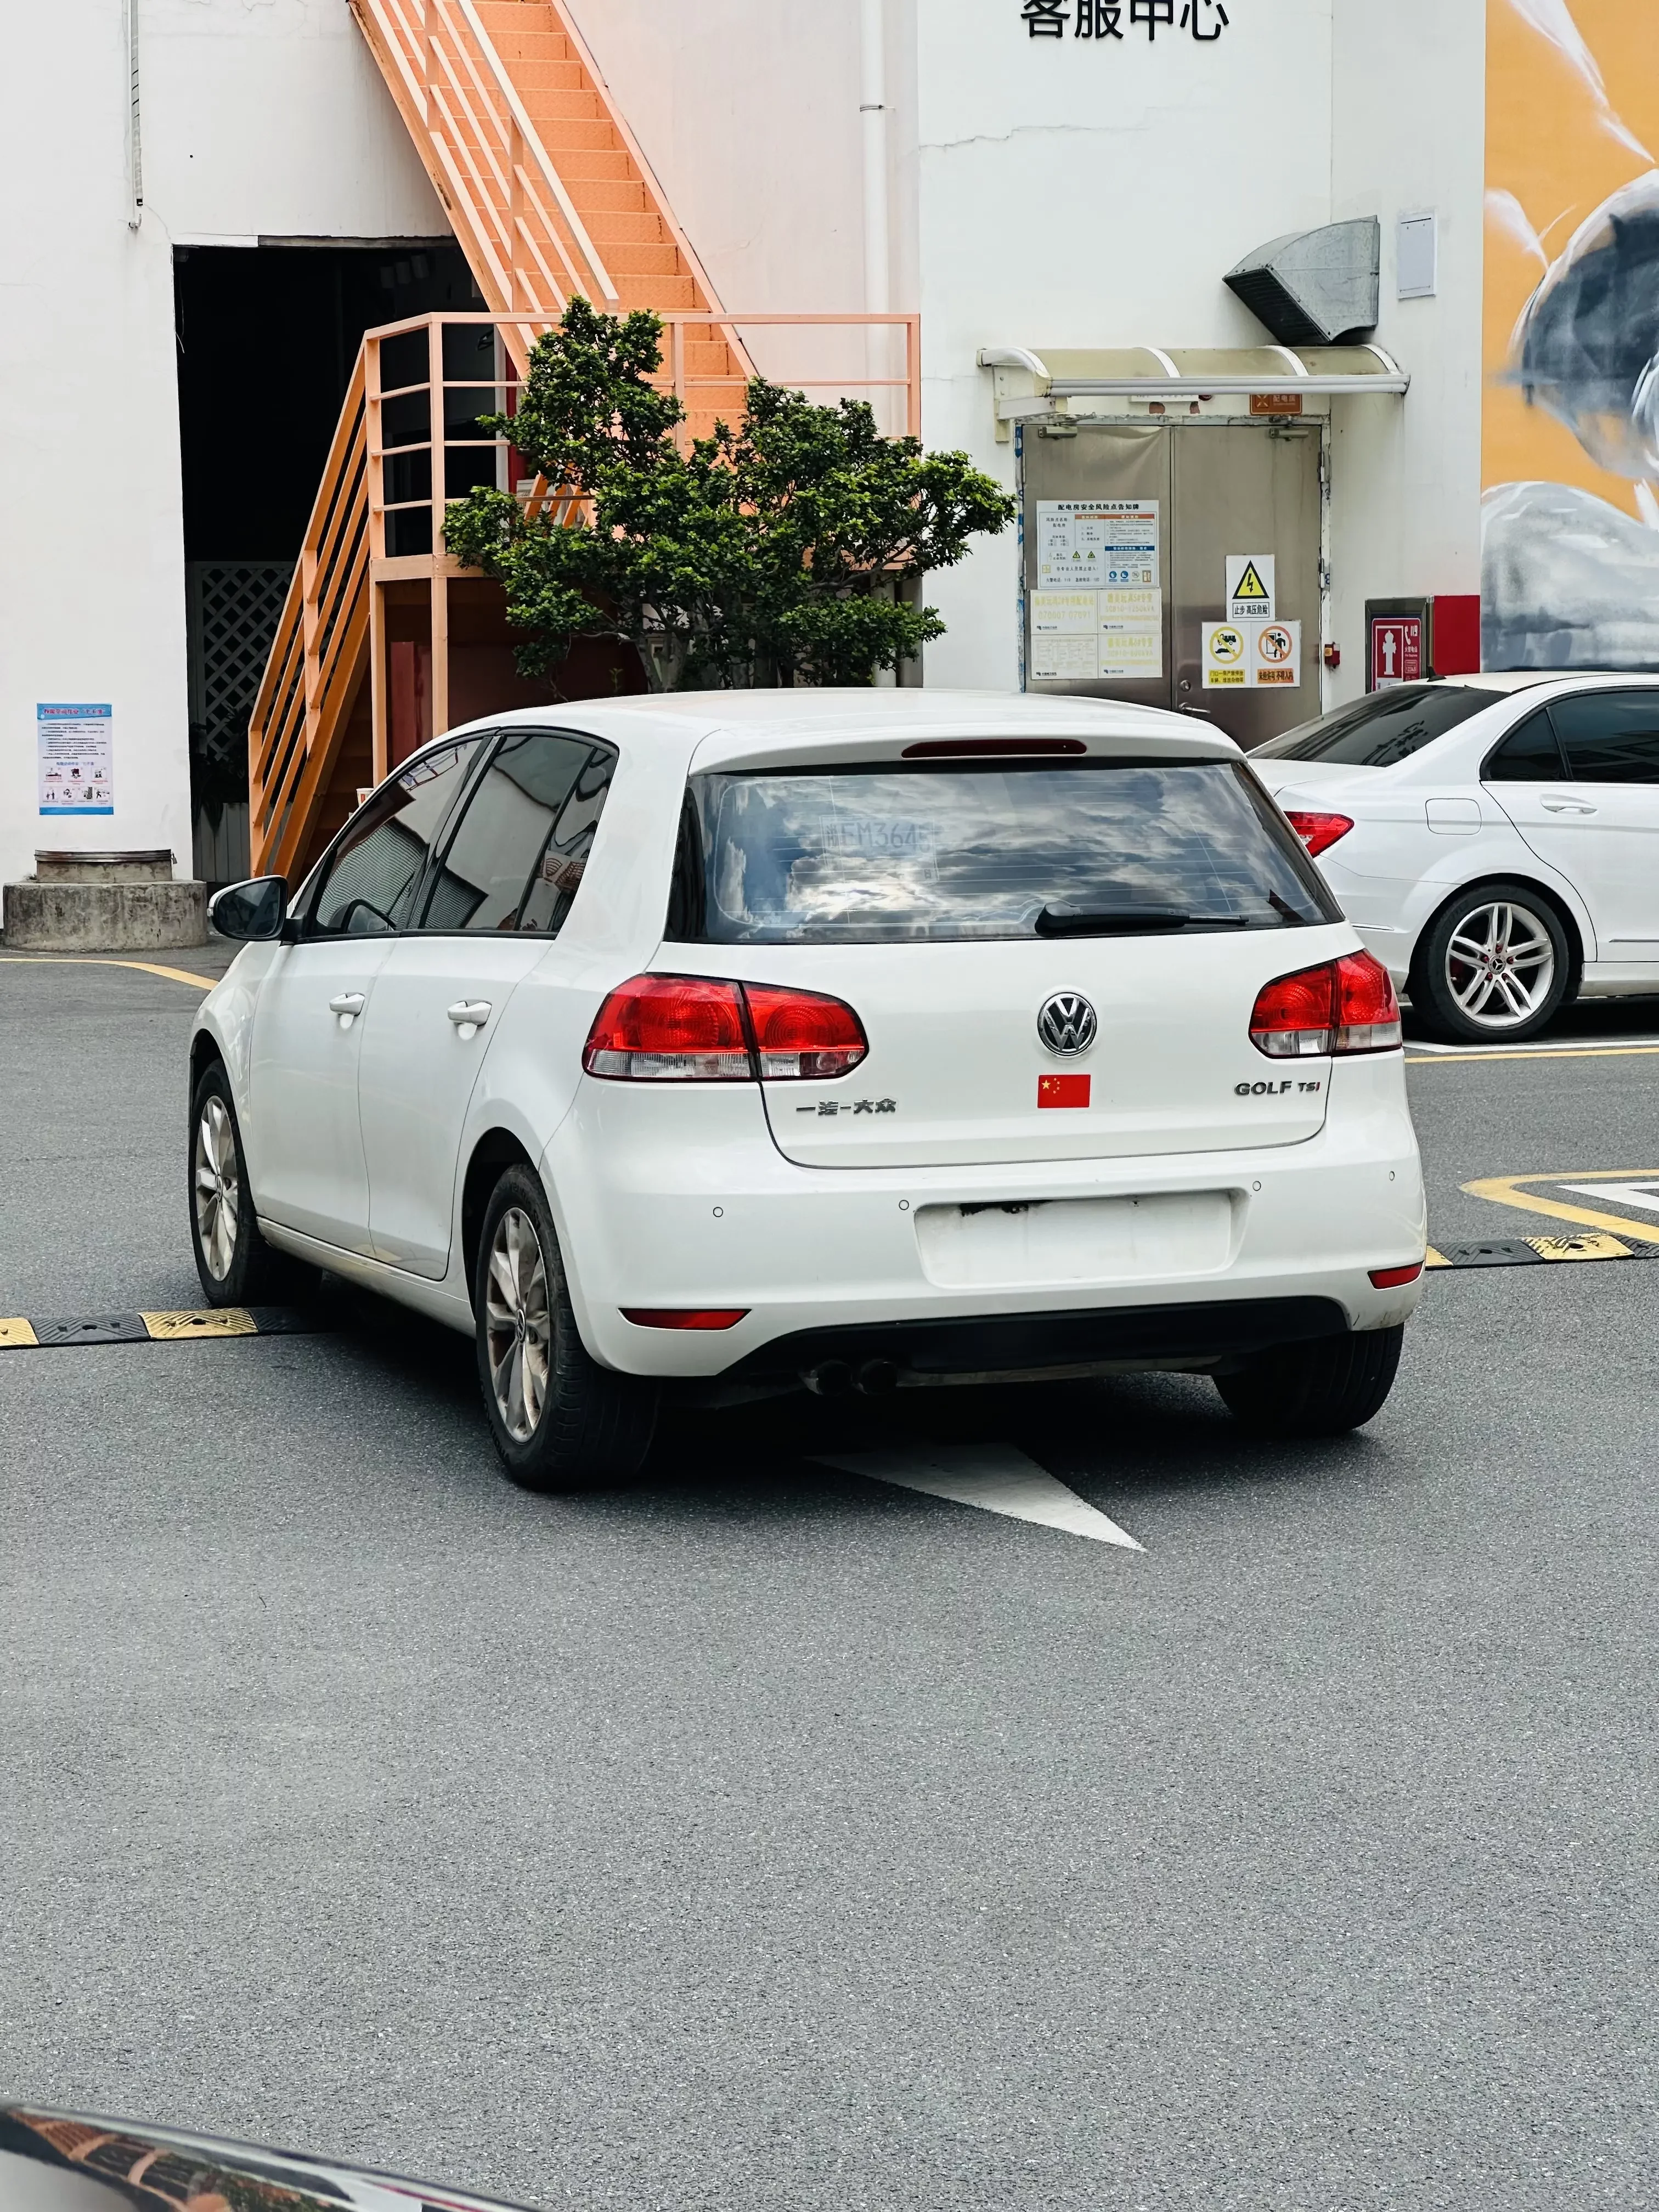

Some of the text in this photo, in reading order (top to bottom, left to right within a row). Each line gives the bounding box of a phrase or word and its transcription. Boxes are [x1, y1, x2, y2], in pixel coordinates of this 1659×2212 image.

[1020, 0, 1229, 41] 客服中心
[1234, 605, 1268, 614] 止步 高压危险
[1259, 670, 1294, 681] 未经许可 不得入内
[1235, 1081, 1321, 1096] GOLF TSI
